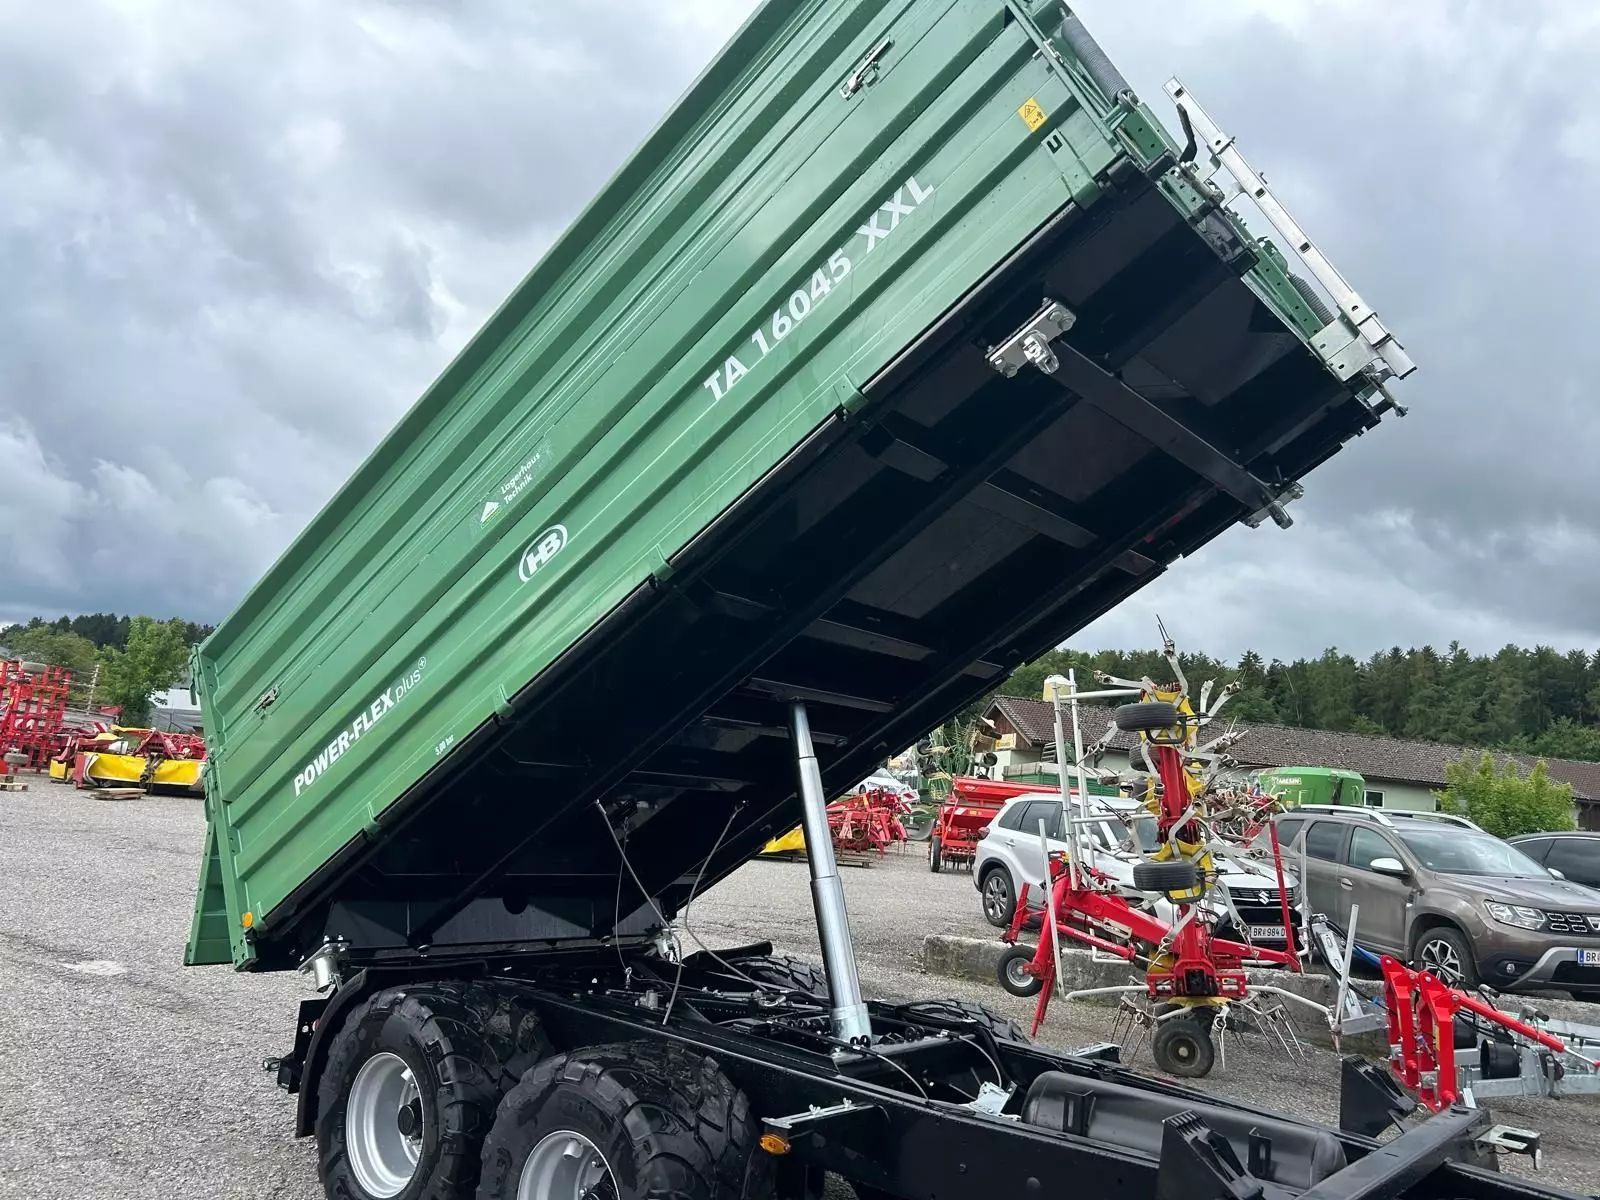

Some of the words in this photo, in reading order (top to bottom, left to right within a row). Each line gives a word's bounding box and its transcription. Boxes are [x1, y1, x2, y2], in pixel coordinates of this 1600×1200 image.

[704, 355, 749, 401] TA
[751, 247, 852, 356] 16045
[855, 176, 934, 254] XXL
[501, 453, 541, 494] Lagerhaus
[504, 474, 533, 504] Technik
[524, 530, 562, 576] HB
[294, 688, 395, 797] POWER-FLEX
